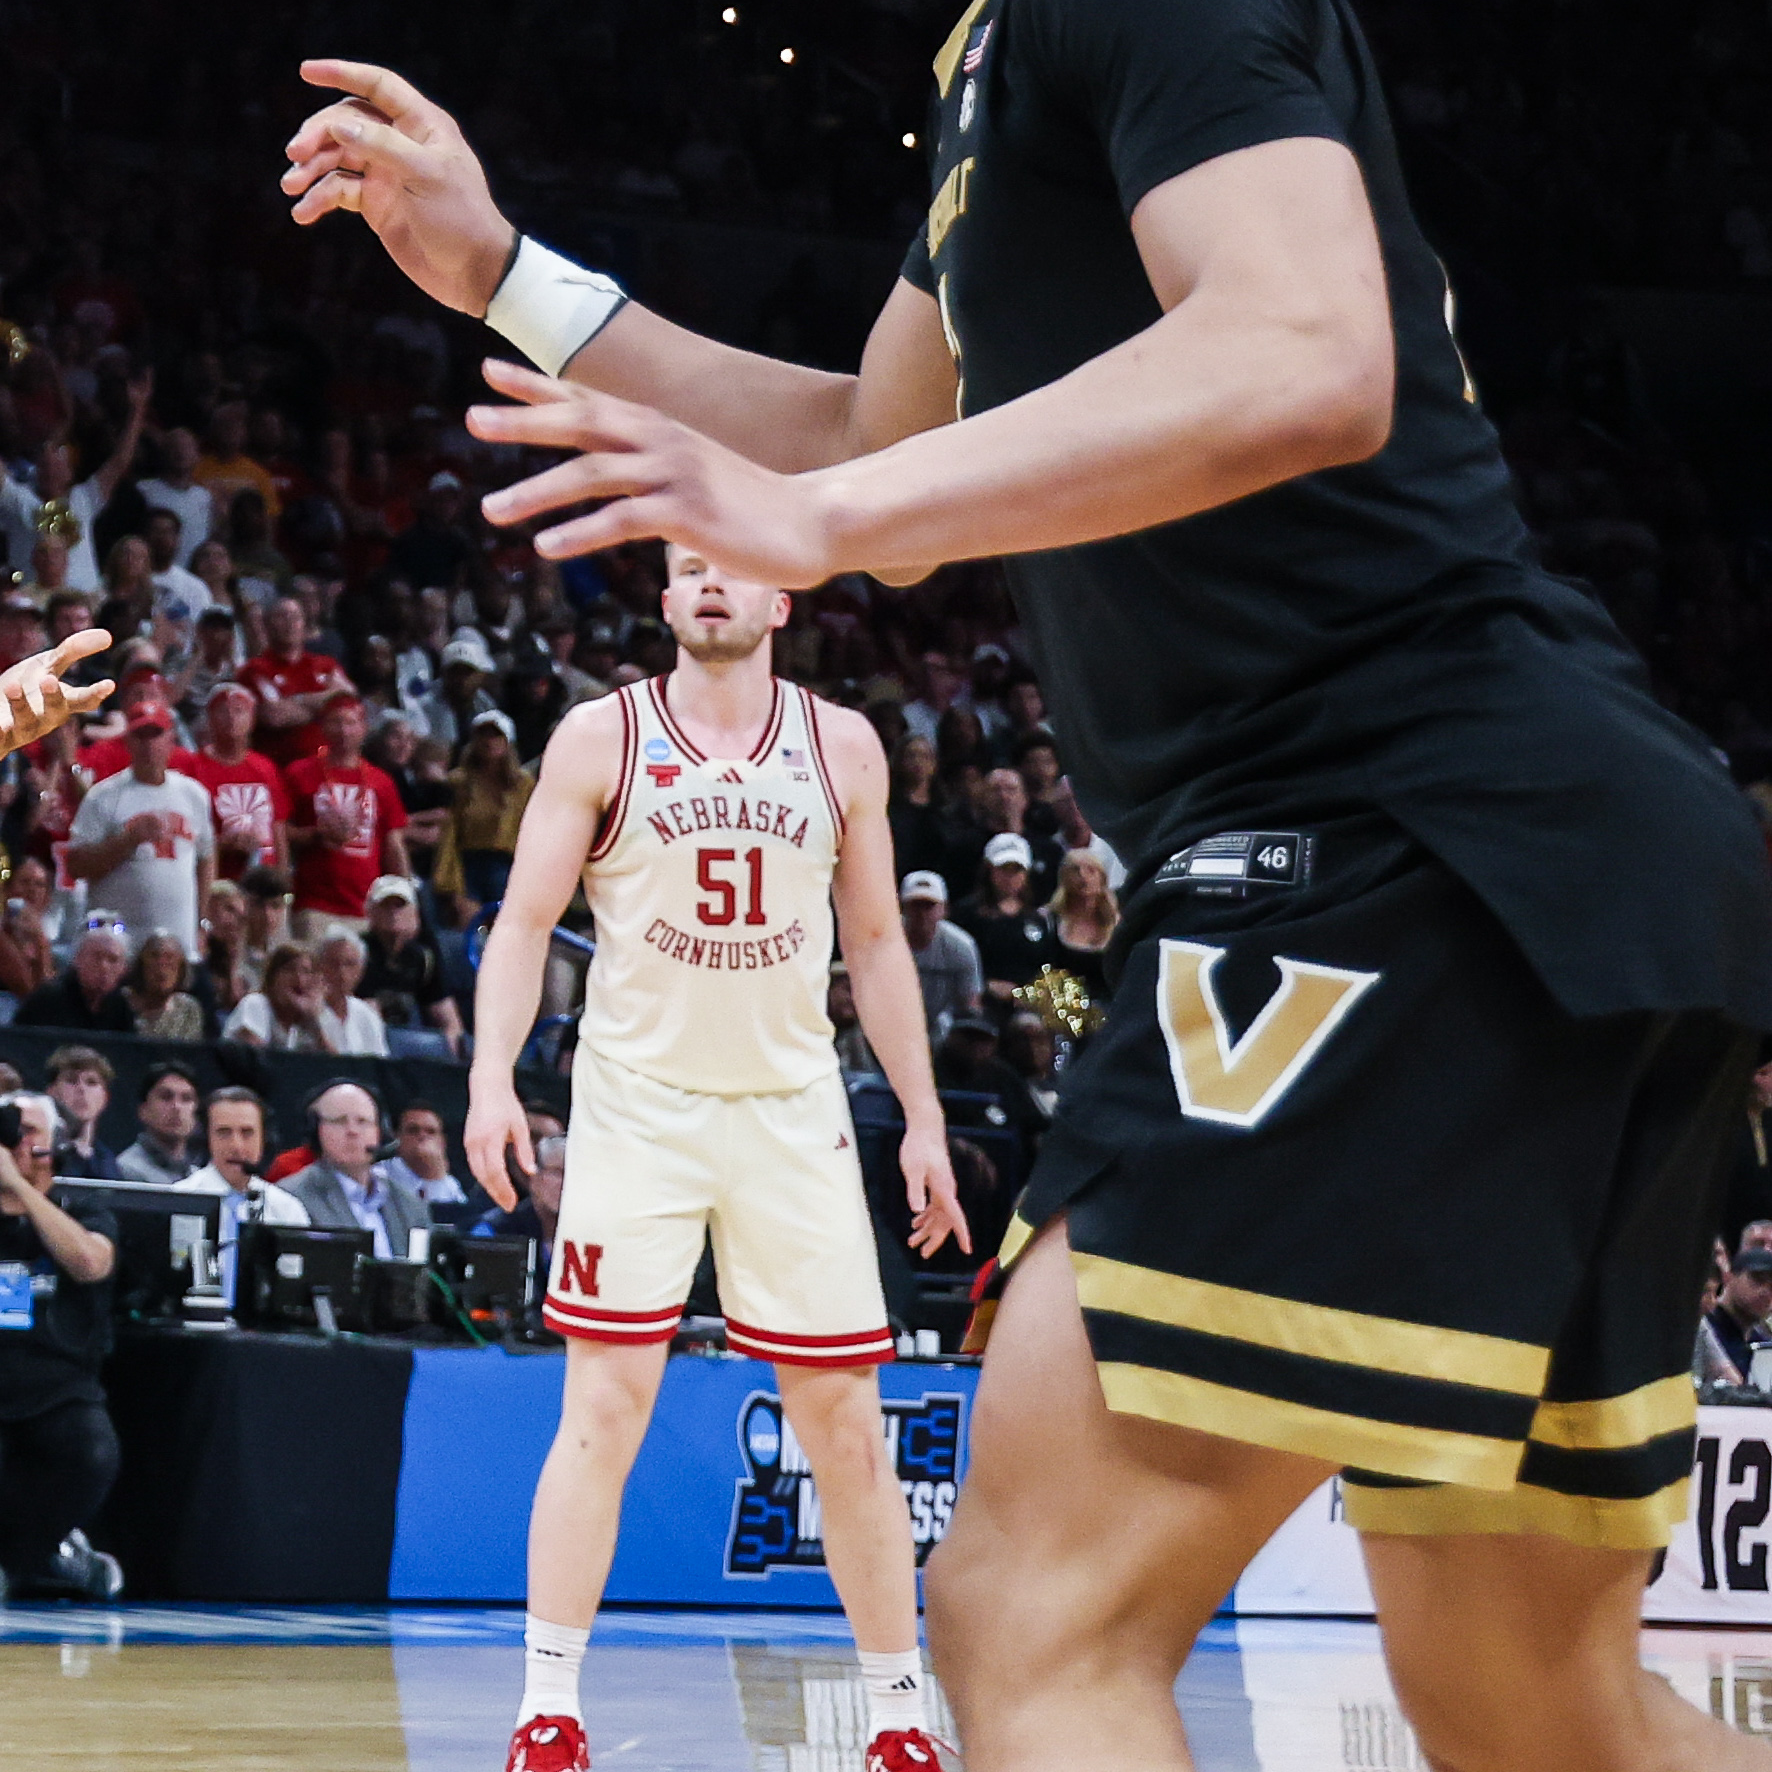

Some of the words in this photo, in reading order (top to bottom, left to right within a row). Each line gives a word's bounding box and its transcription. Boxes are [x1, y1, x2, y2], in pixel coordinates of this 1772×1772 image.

[646, 796, 809, 849] NEBRASKA
[1256, 845, 1289, 869] 46
[696, 847, 767, 926] 51
[1157, 938, 1378, 1127] V
[559, 1239, 604, 1297] N
